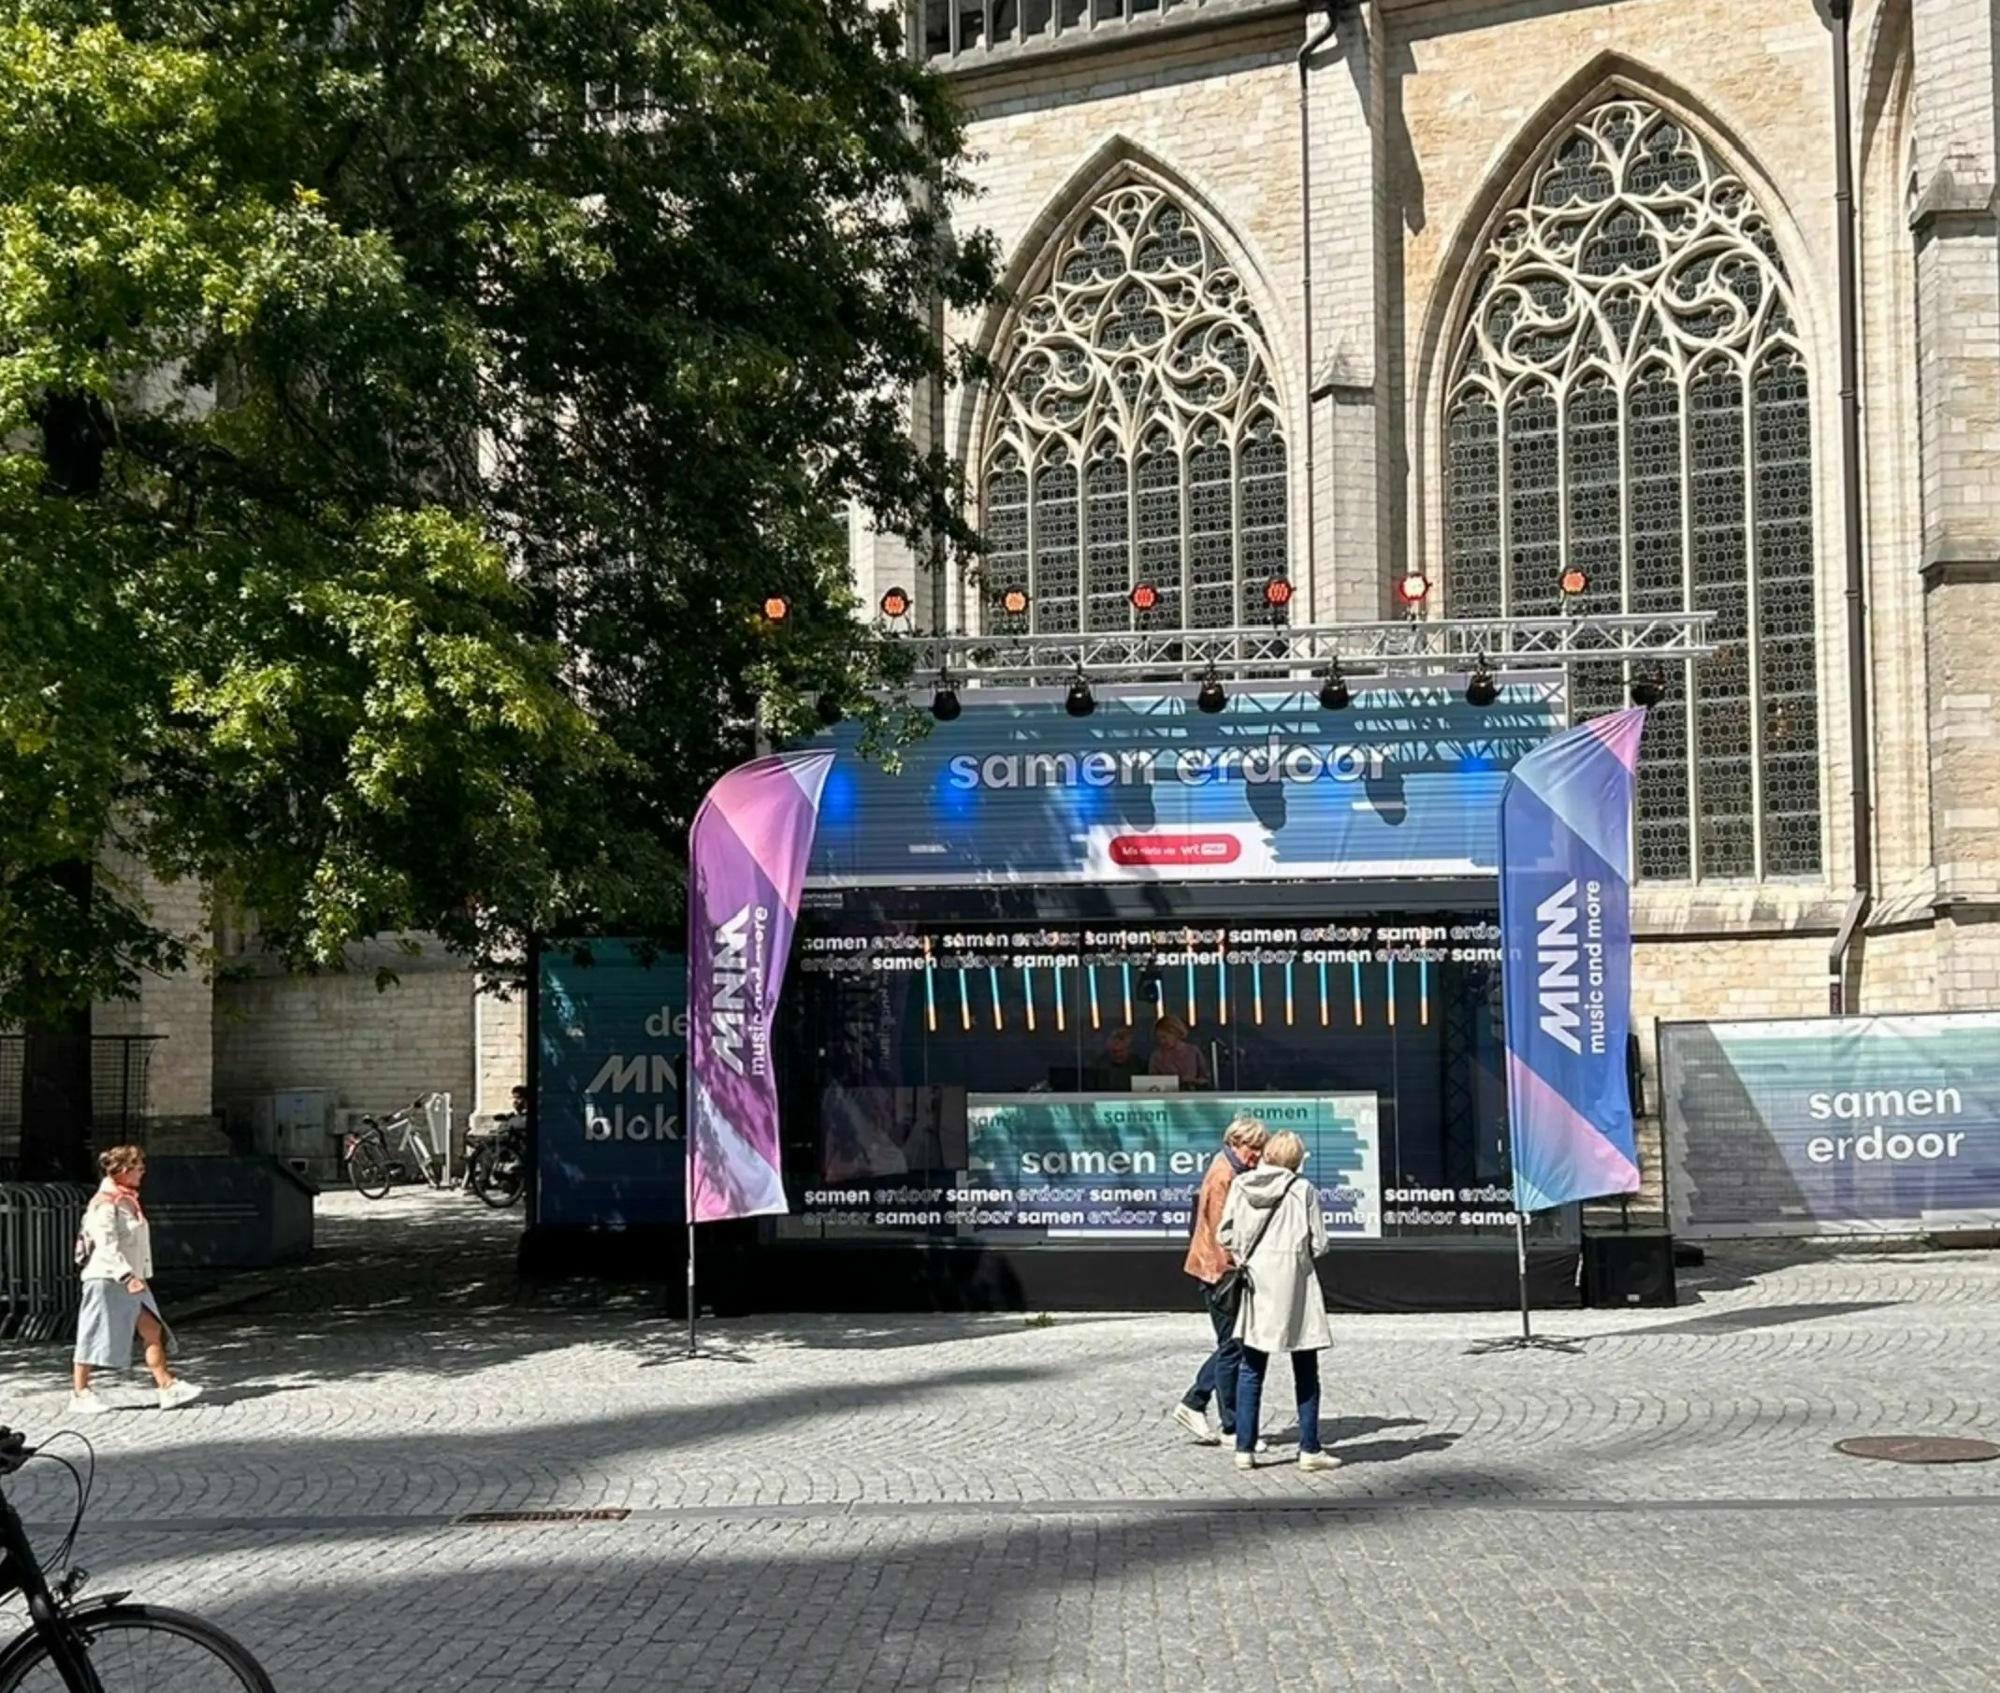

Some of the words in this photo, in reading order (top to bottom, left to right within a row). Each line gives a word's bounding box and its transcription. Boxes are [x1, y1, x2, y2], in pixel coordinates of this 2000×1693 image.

[949, 751, 1155, 789] samen
[1176, 735, 1386, 785] erdoor
[1586, 880, 1602, 938] more
[943, 932, 1009, 948] samen
[1085, 930, 1150, 946] samen
[1229, 928, 1297, 943] samen
[1300, 924, 1371, 942] erdoor
[1377, 926, 1446, 941] samen
[1449, 920, 1501, 940] erdo
[872, 956, 937, 971] samen
[1012, 953, 1079, 968] samen
[1155, 950, 1224, 966] samen
[1226, 946, 1297, 964] erdoor
[1302, 949, 1371, 963] samen
[1375, 944, 1449, 962] erdoor
[1536, 879, 1582, 1055] MNM
[1583, 942, 1603, 986] and
[711, 903, 750, 1076] MNM
[1584, 990, 1605, 1054] music
[749, 1013, 766, 1076] music
[584, 1054, 678, 1093] MN
[584, 1103, 679, 1141] blok
[1103, 1107, 1168, 1123] samen
[1809, 1087, 1962, 1119] samen
[1021, 1148, 1155, 1175] samen
[1807, 1125, 1965, 1163] erdoor
[804, 1189, 870, 1205] samen
[946, 1188, 1012, 1203] samen
[1015, 1184, 1085, 1203] erdoor
[1089, 1187, 1157, 1202] samen
[1384, 1187, 1455, 1203] samen
[1459, 1183, 1515, 1203] erdo
[874, 1210, 941, 1226] samen
[944, 1206, 1016, 1225] erdoor
[1017, 1210, 1084, 1225] samen
[1087, 1206, 1156, 1225] erdoor
[1322, 1211, 1379, 1225] amen
[1384, 1206, 1455, 1225] erdoor
[1460, 1210, 1531, 1226] samen
